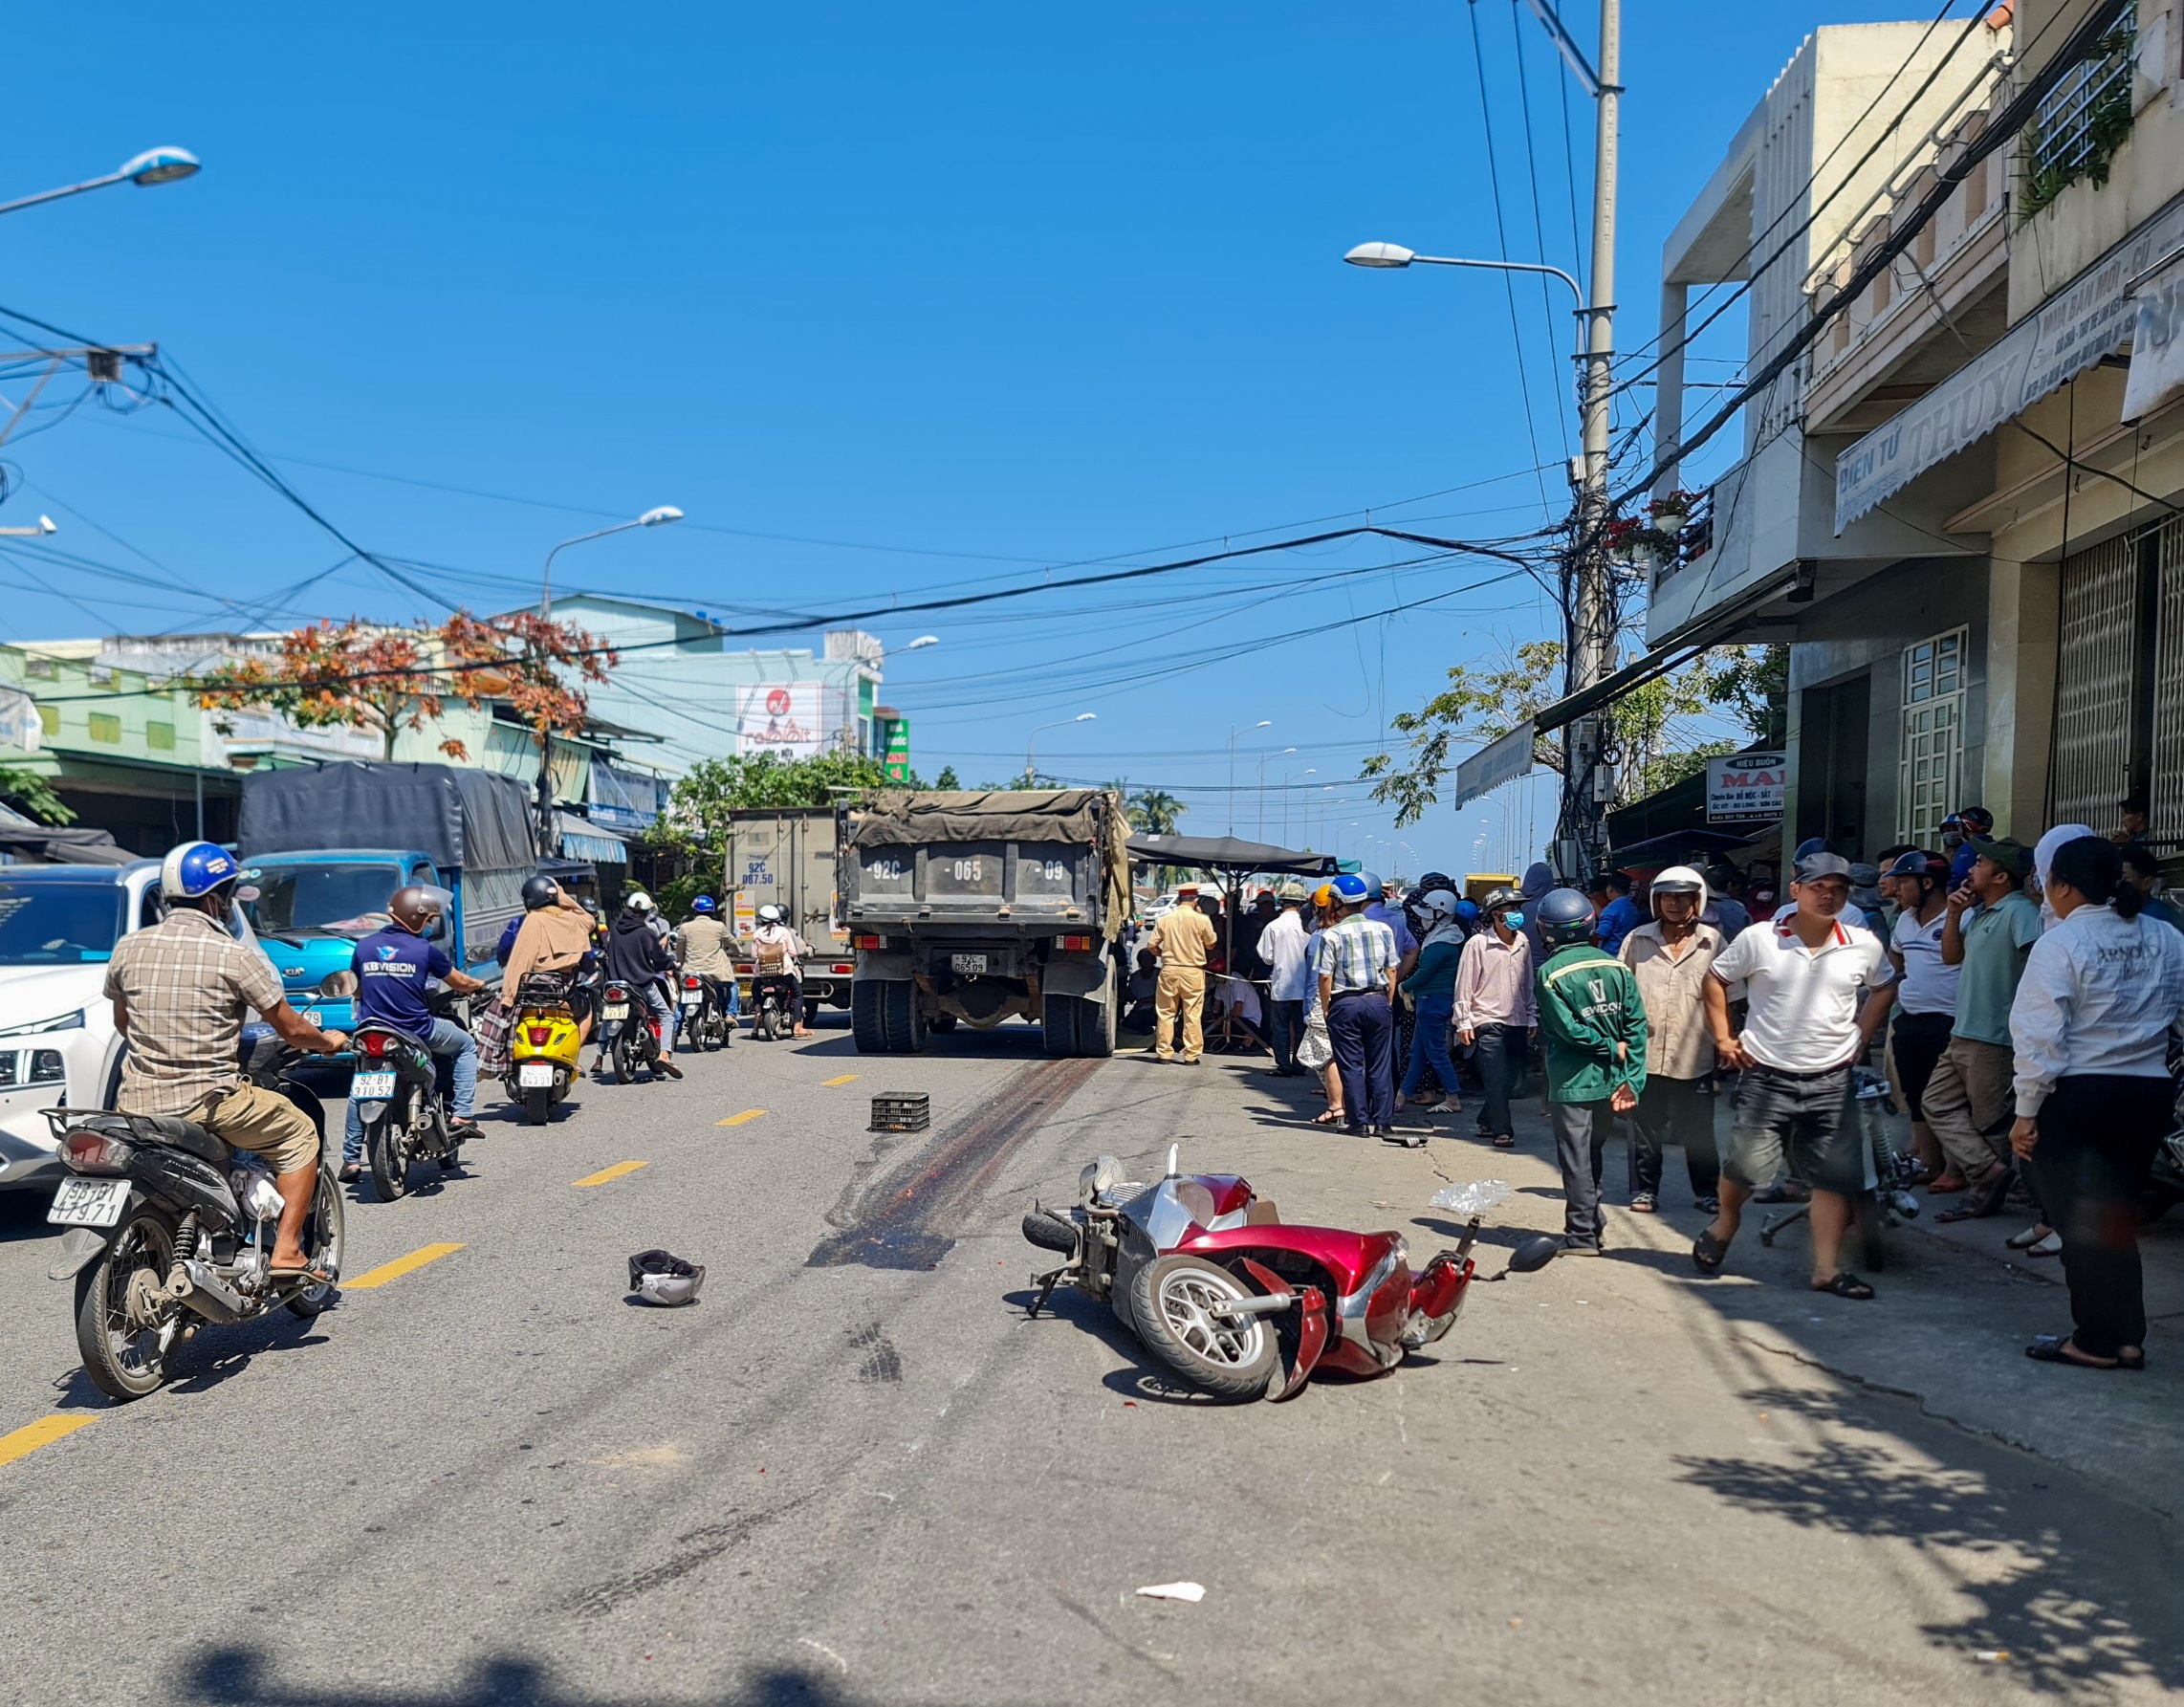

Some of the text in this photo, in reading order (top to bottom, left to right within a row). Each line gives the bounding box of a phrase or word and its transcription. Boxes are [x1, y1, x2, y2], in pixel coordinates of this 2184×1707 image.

[886, 753, 906, 763] MINH
[749, 862, 766, 873] 92C
[954, 861, 982, 882] 065
[1045, 861, 1063, 881] 09
[742, 874, 774, 885] 087.50
[57, 1201, 117, 1223] 179.71
